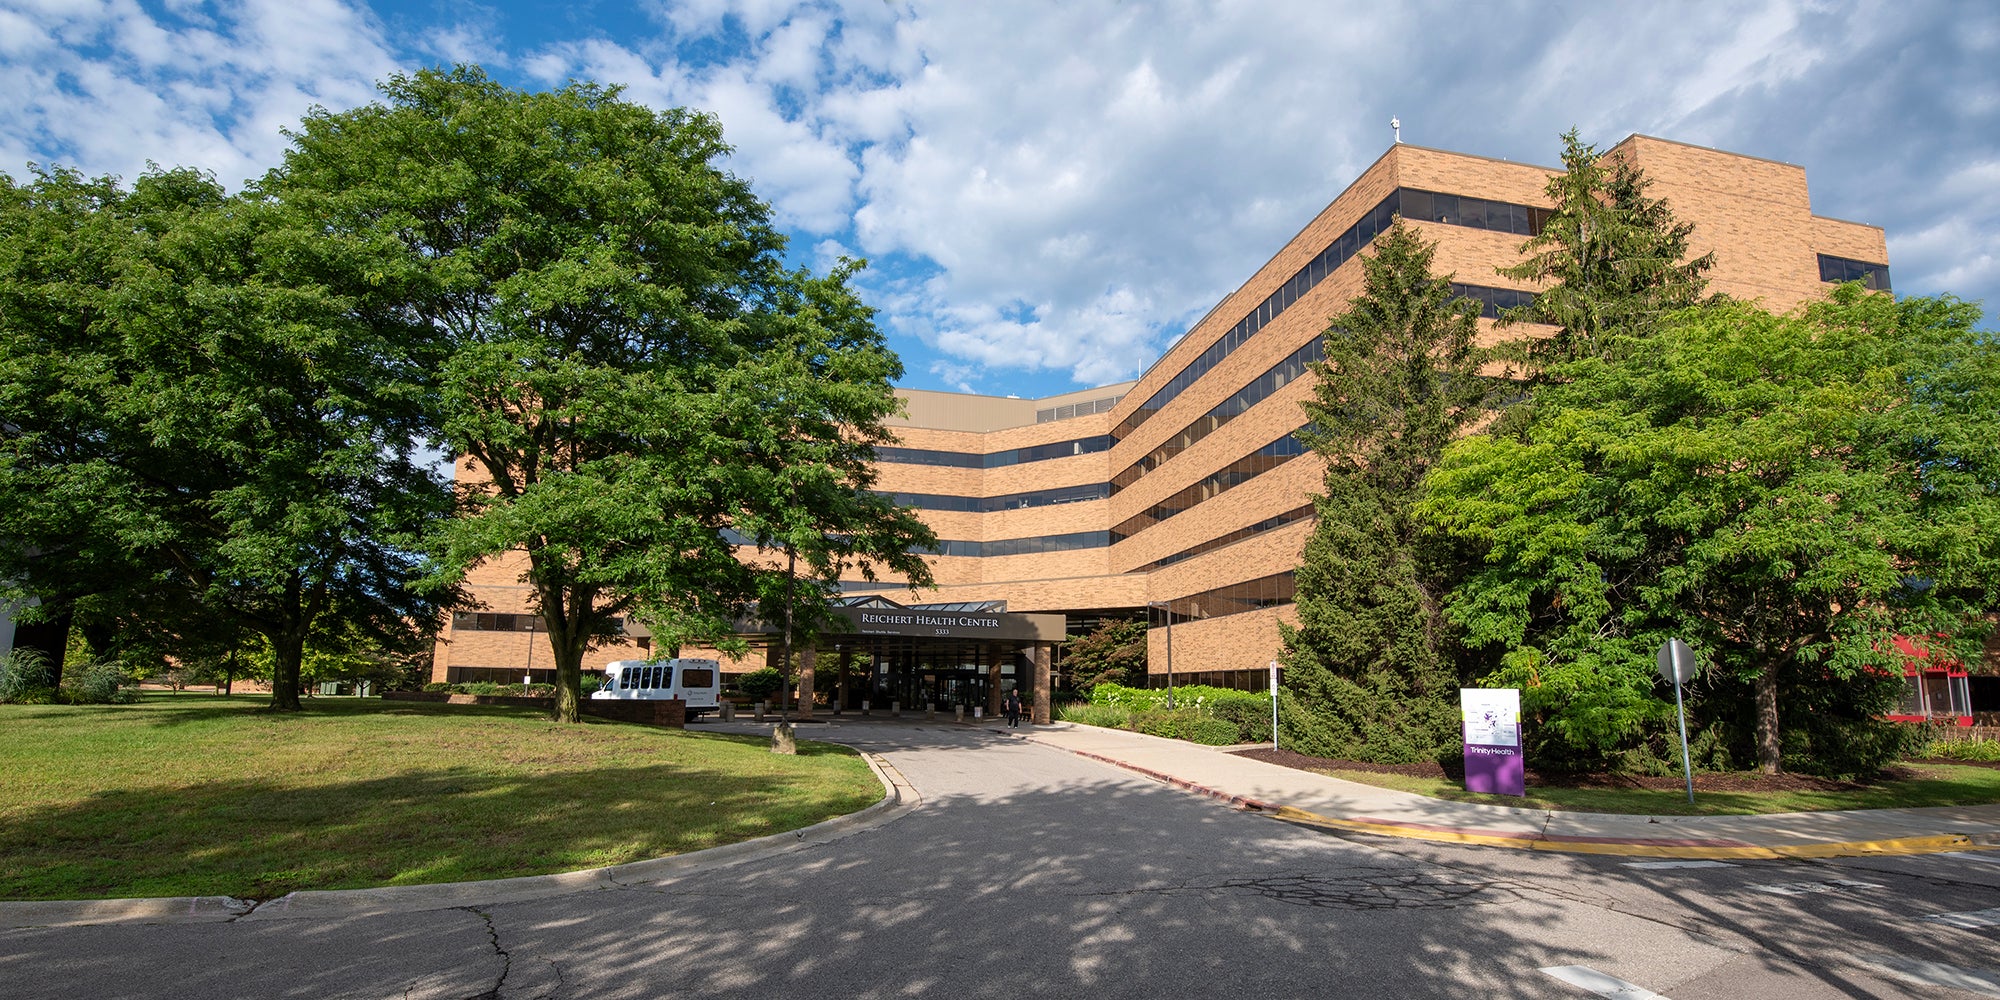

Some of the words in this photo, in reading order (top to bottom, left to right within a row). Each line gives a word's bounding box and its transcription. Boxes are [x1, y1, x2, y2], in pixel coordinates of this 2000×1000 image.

[862, 613, 913, 624] REICHERT
[916, 615, 956, 625] HEALTH
[959, 617, 999, 628] CENTER
[1470, 746, 1491, 755] Trinity
[1491, 748, 1515, 756] Health
